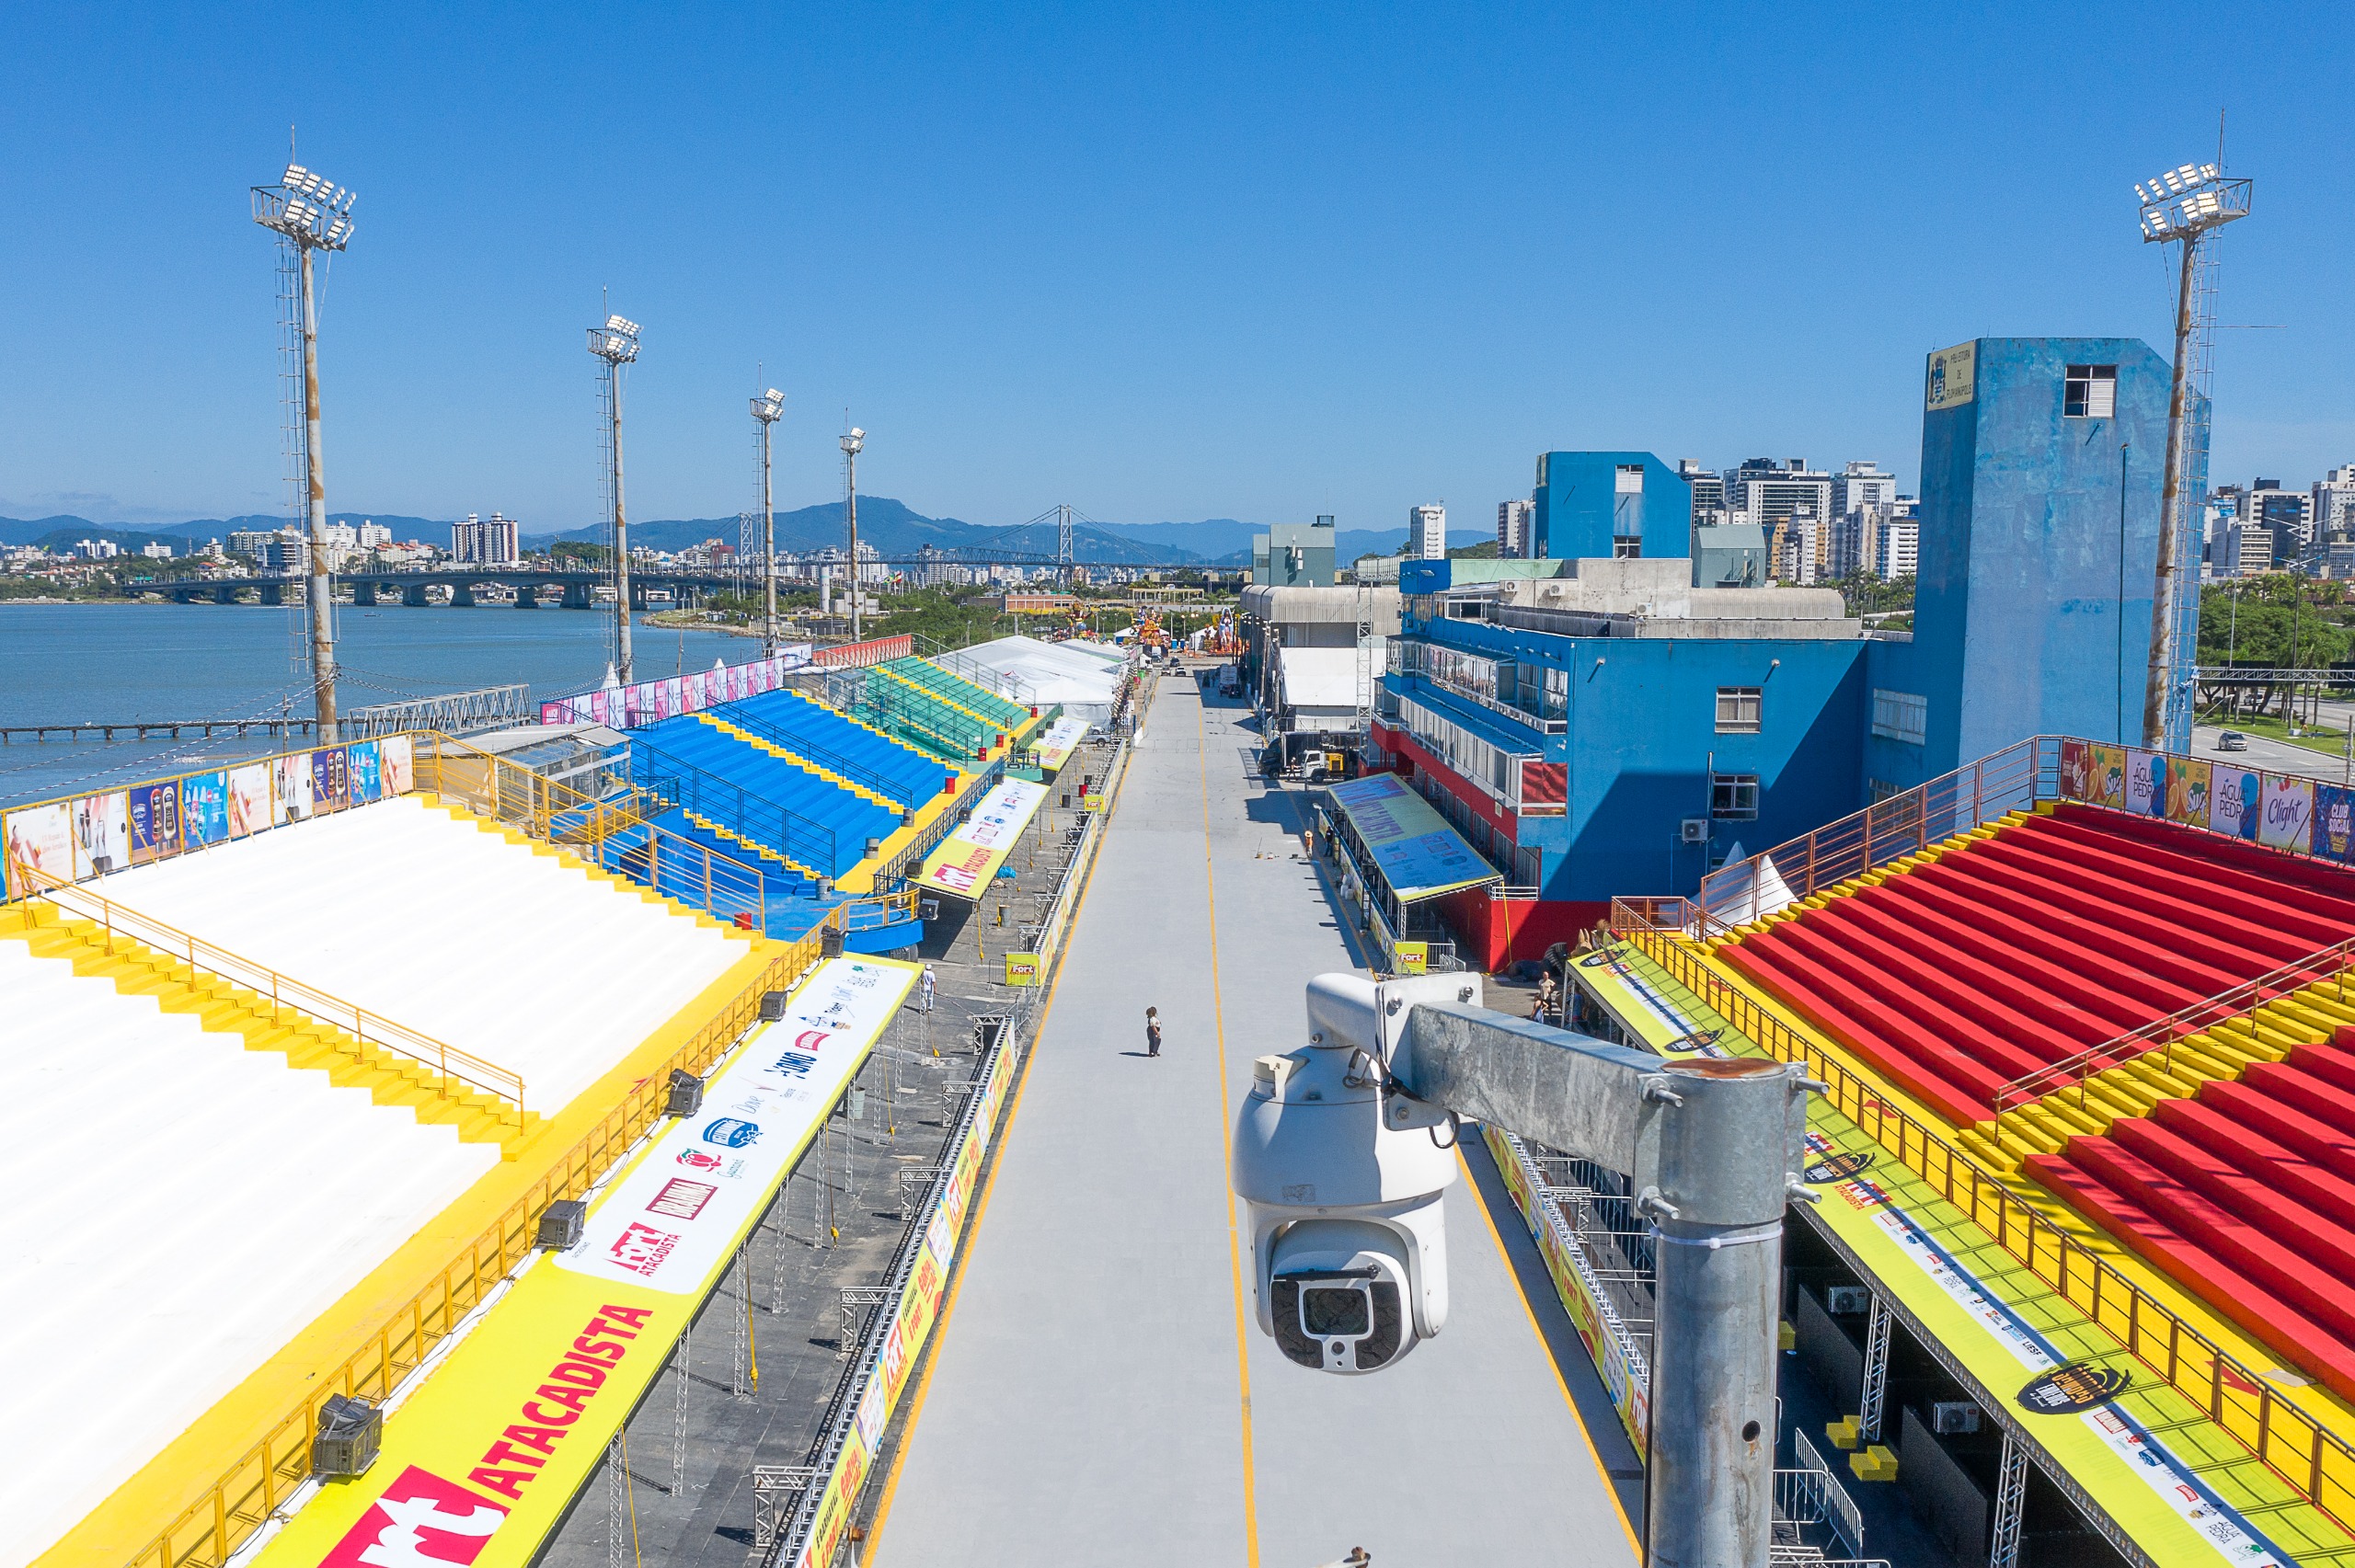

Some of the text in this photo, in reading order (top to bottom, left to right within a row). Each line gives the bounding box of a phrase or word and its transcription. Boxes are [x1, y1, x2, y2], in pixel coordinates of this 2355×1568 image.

[2219, 778, 2246, 804] ÁGUA
[2268, 798, 2303, 831] Clight
[2331, 804, 2349, 818] CLUB
[1399, 953, 1423, 961] Fort
[1012, 964, 1035, 973] Fort
[775, 1052, 817, 1073] OMO
[731, 1095, 764, 1115] Dove
[650, 1180, 715, 1219] BRAHMA
[606, 1223, 666, 1271] Fort
[639, 1234, 682, 1276] ATACADISTA
[2022, 1341, 2042, 1356] LIESF
[467, 1304, 653, 1501] ATACADISTA
[2208, 1525, 2231, 1544] PEDRA
